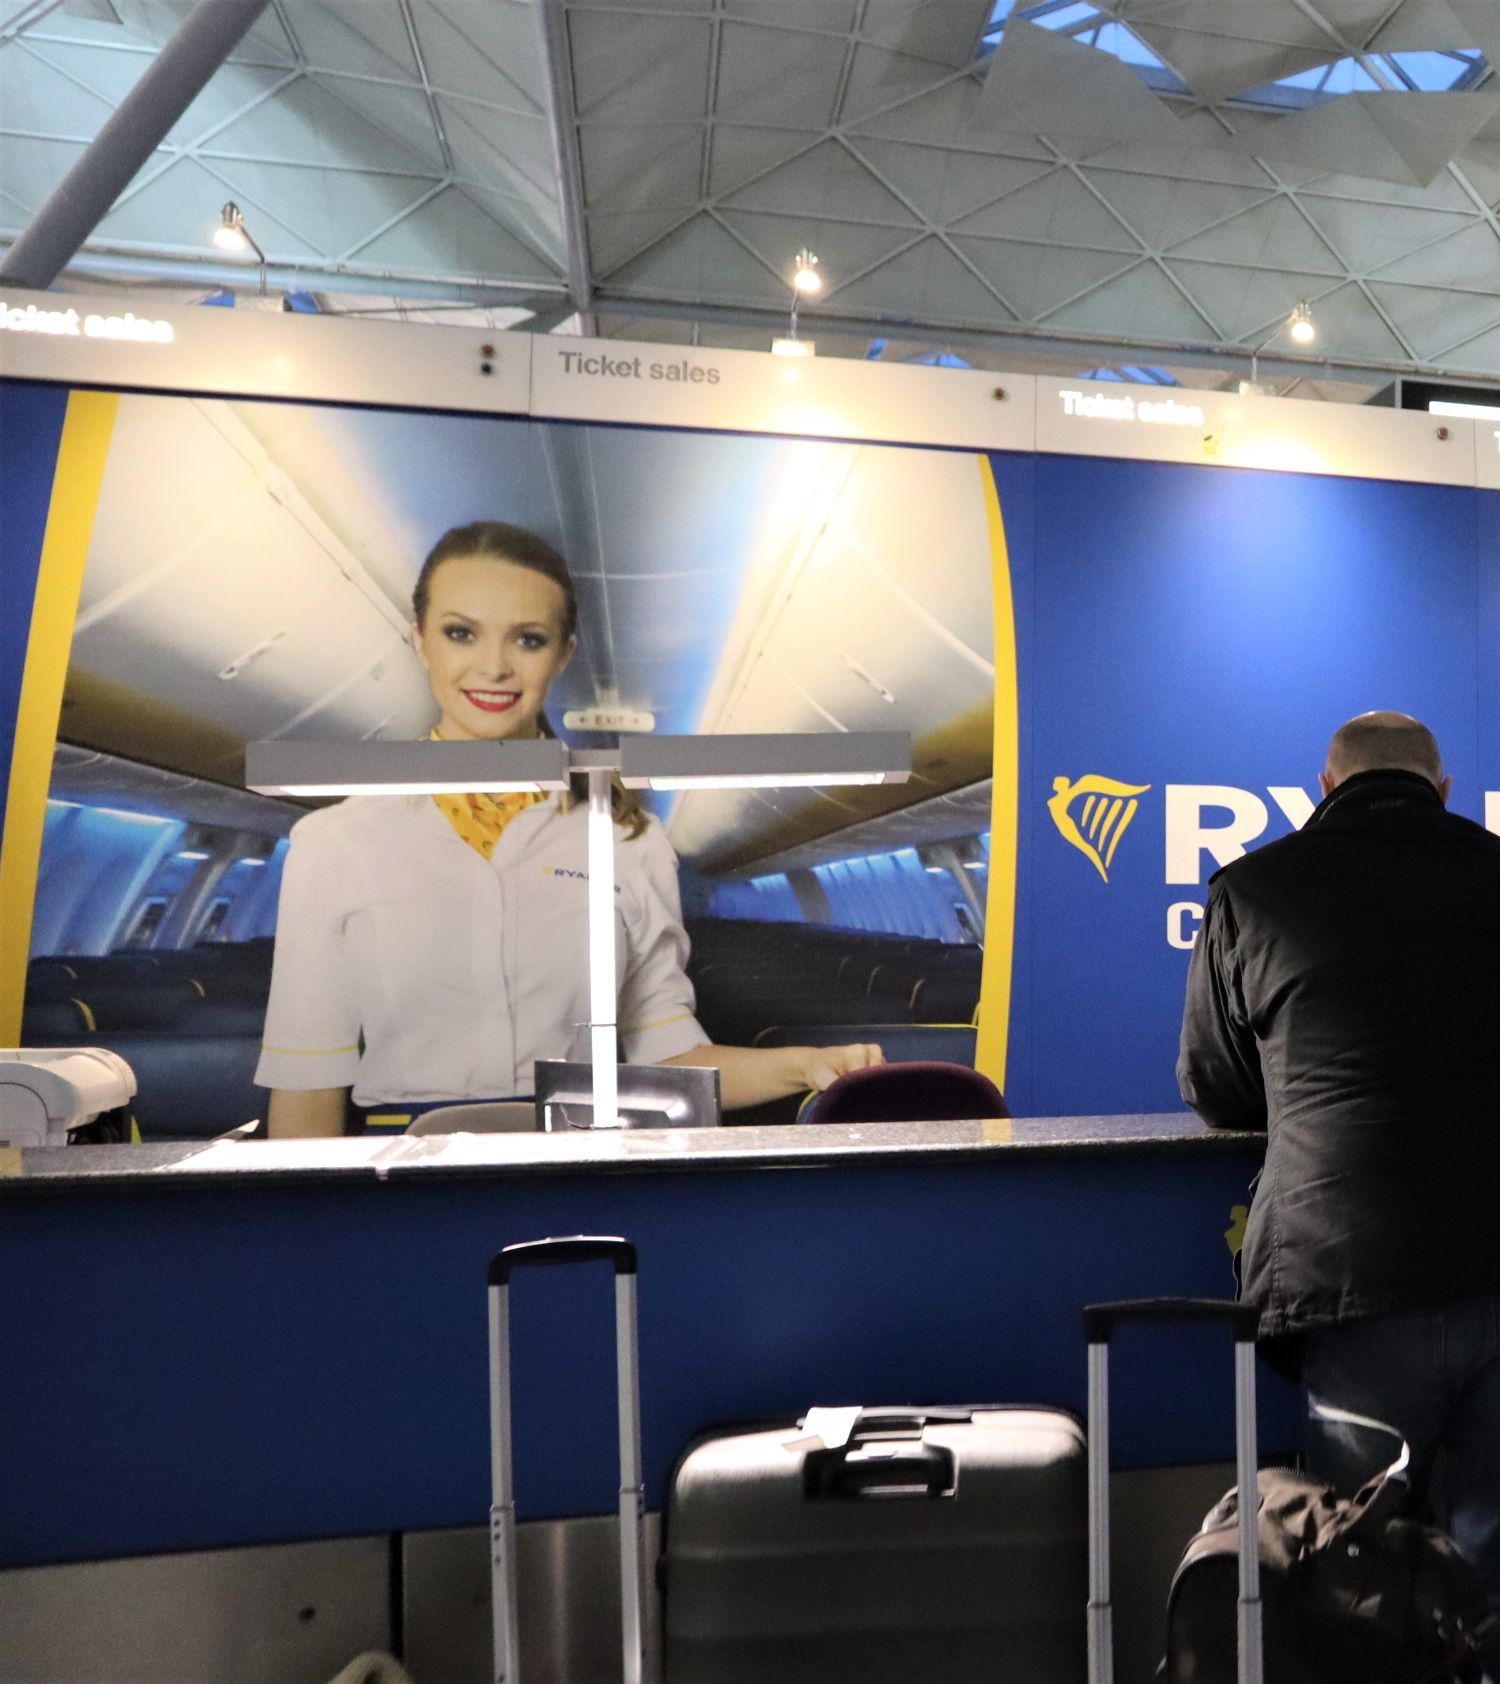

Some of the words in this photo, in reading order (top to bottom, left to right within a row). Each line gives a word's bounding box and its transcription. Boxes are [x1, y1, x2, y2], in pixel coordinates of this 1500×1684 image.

[0, 303, 79, 335] icket
[558, 350, 642, 379] Ticket
[650, 360, 721, 385] sales
[1058, 390, 1135, 420] Ticket
